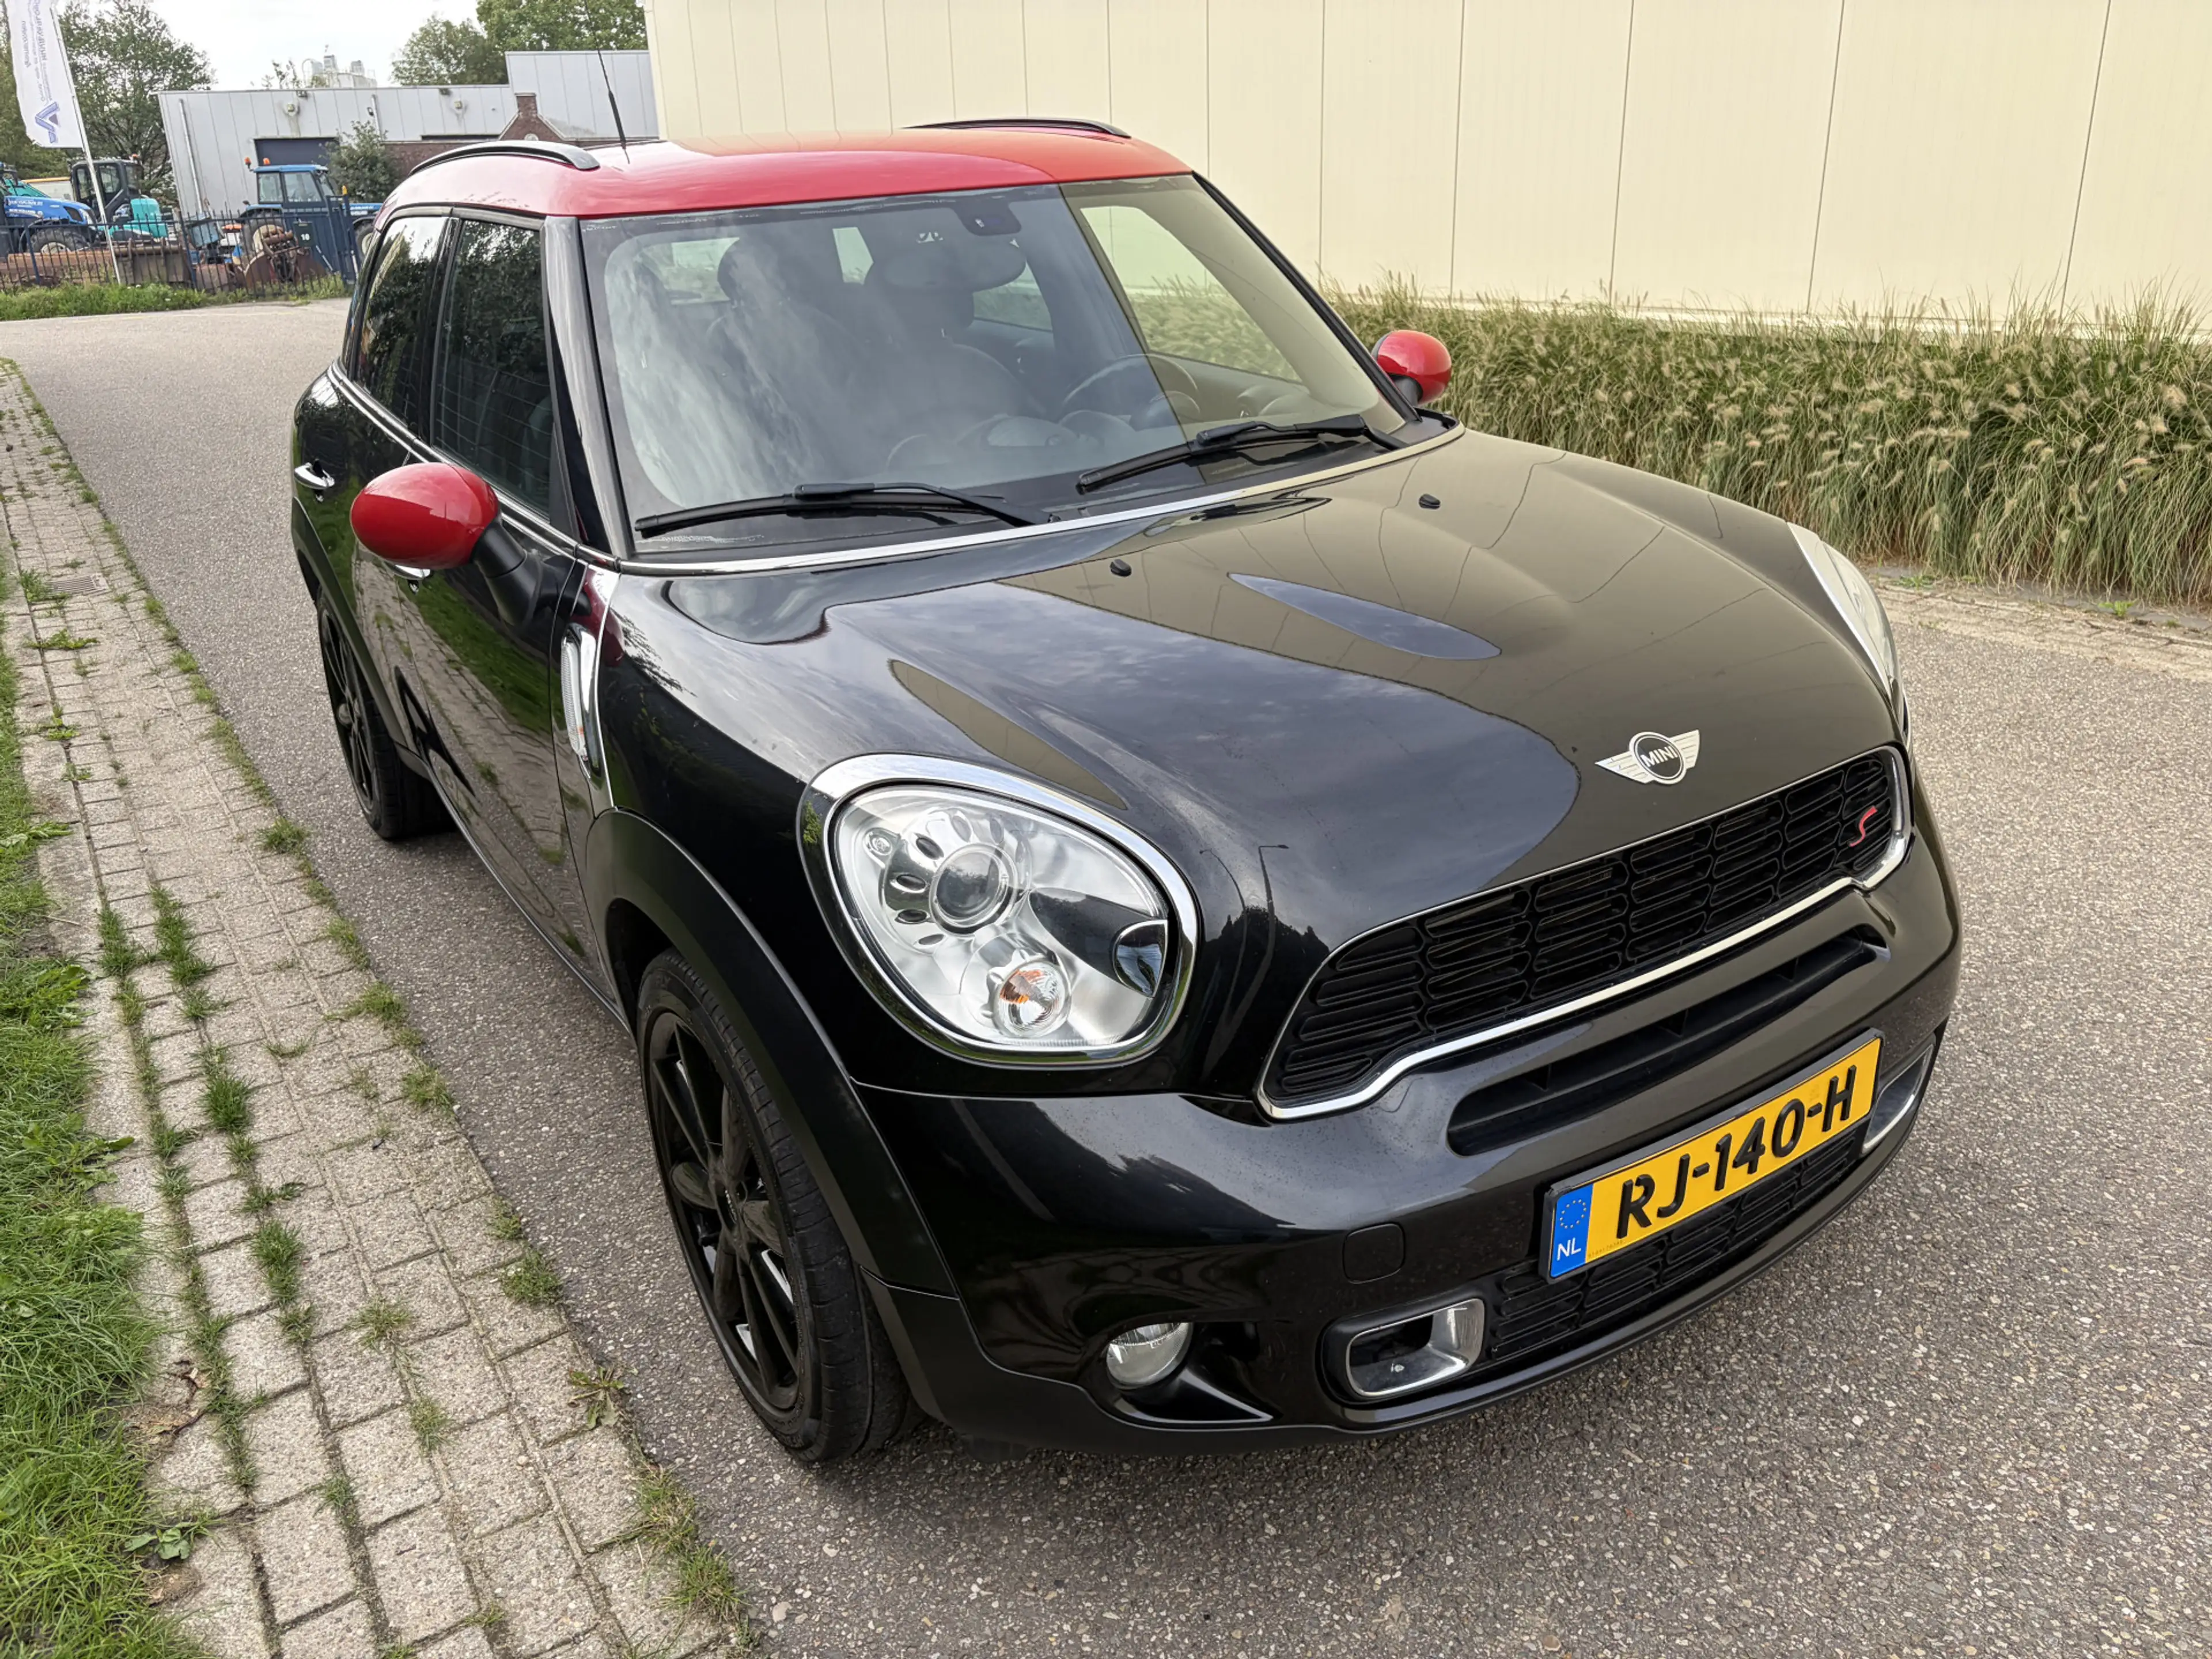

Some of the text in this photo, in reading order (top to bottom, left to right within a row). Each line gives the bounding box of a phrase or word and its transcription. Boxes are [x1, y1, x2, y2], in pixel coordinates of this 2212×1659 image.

[1639, 745, 1679, 768] MINI
[1849, 806, 1878, 847] S
[1616, 1065, 1857, 1239] RJ-140-H
[1556, 1237, 1582, 1262] NL
